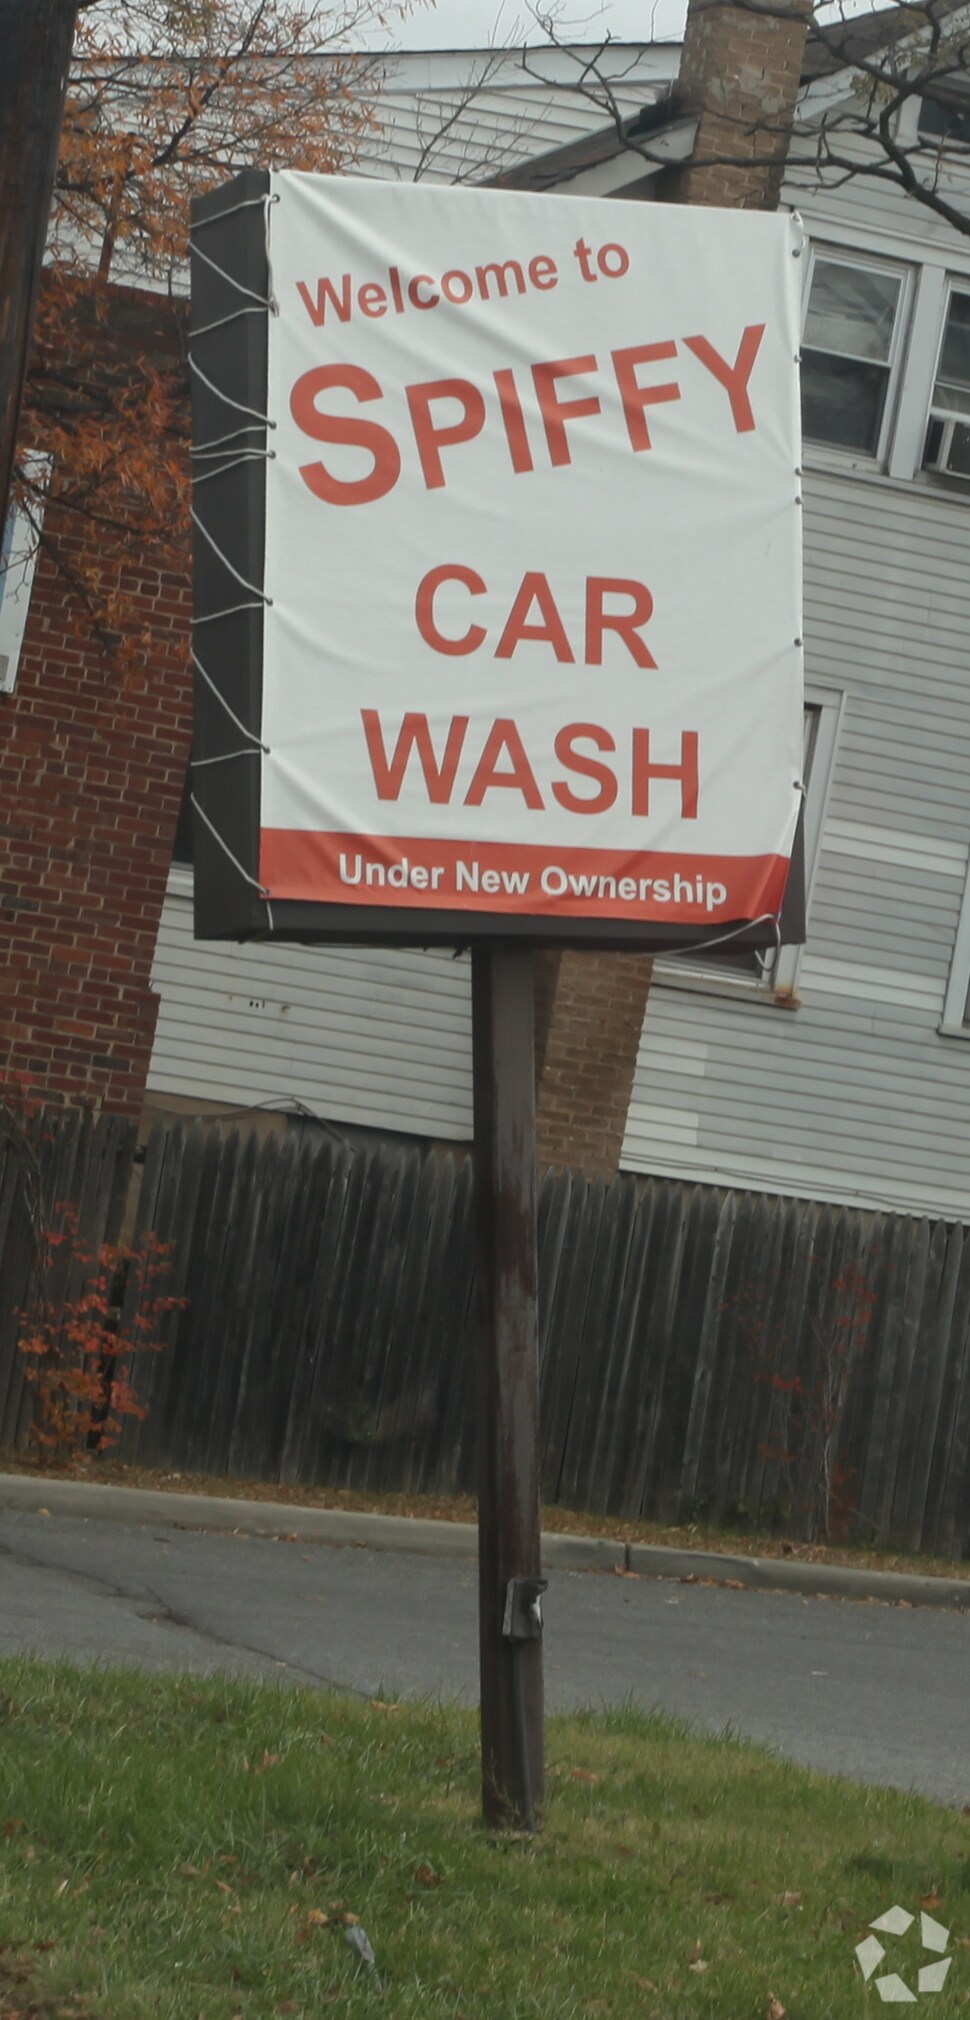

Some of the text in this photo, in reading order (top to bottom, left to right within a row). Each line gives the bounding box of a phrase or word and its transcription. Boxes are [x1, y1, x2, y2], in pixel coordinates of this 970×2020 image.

[296, 236, 629, 326] Welcome to
[289, 324, 764, 506] SPIFFY
[415, 564, 658, 669] CAR
[361, 709, 699, 819] WASH
[338, 852, 729, 912] Under New Ownership
